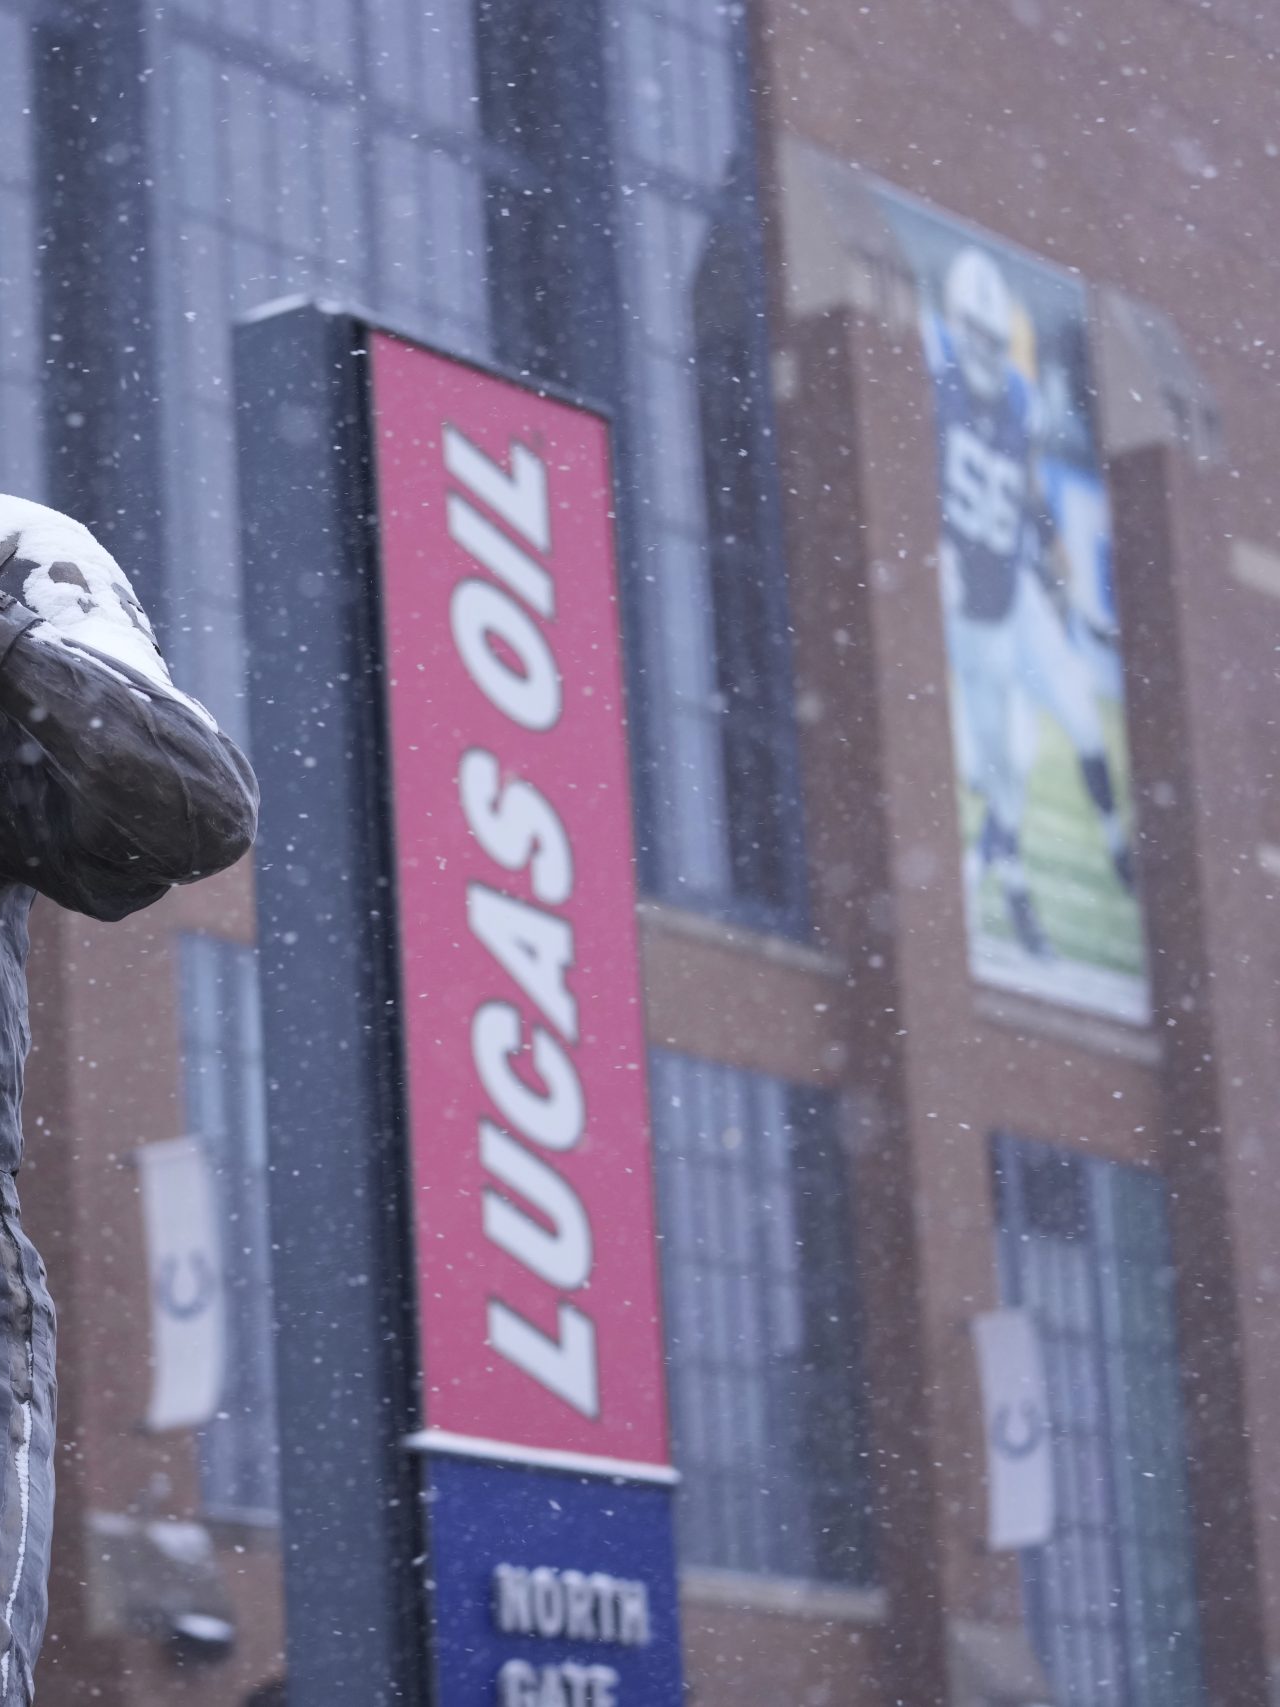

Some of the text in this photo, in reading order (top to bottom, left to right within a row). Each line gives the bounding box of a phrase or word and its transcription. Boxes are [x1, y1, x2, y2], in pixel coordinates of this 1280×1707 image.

[441, 425, 599, 1419] LUCAS OIL
[493, 1562, 652, 1645] NORTH
[498, 1658, 619, 1707] GATE
